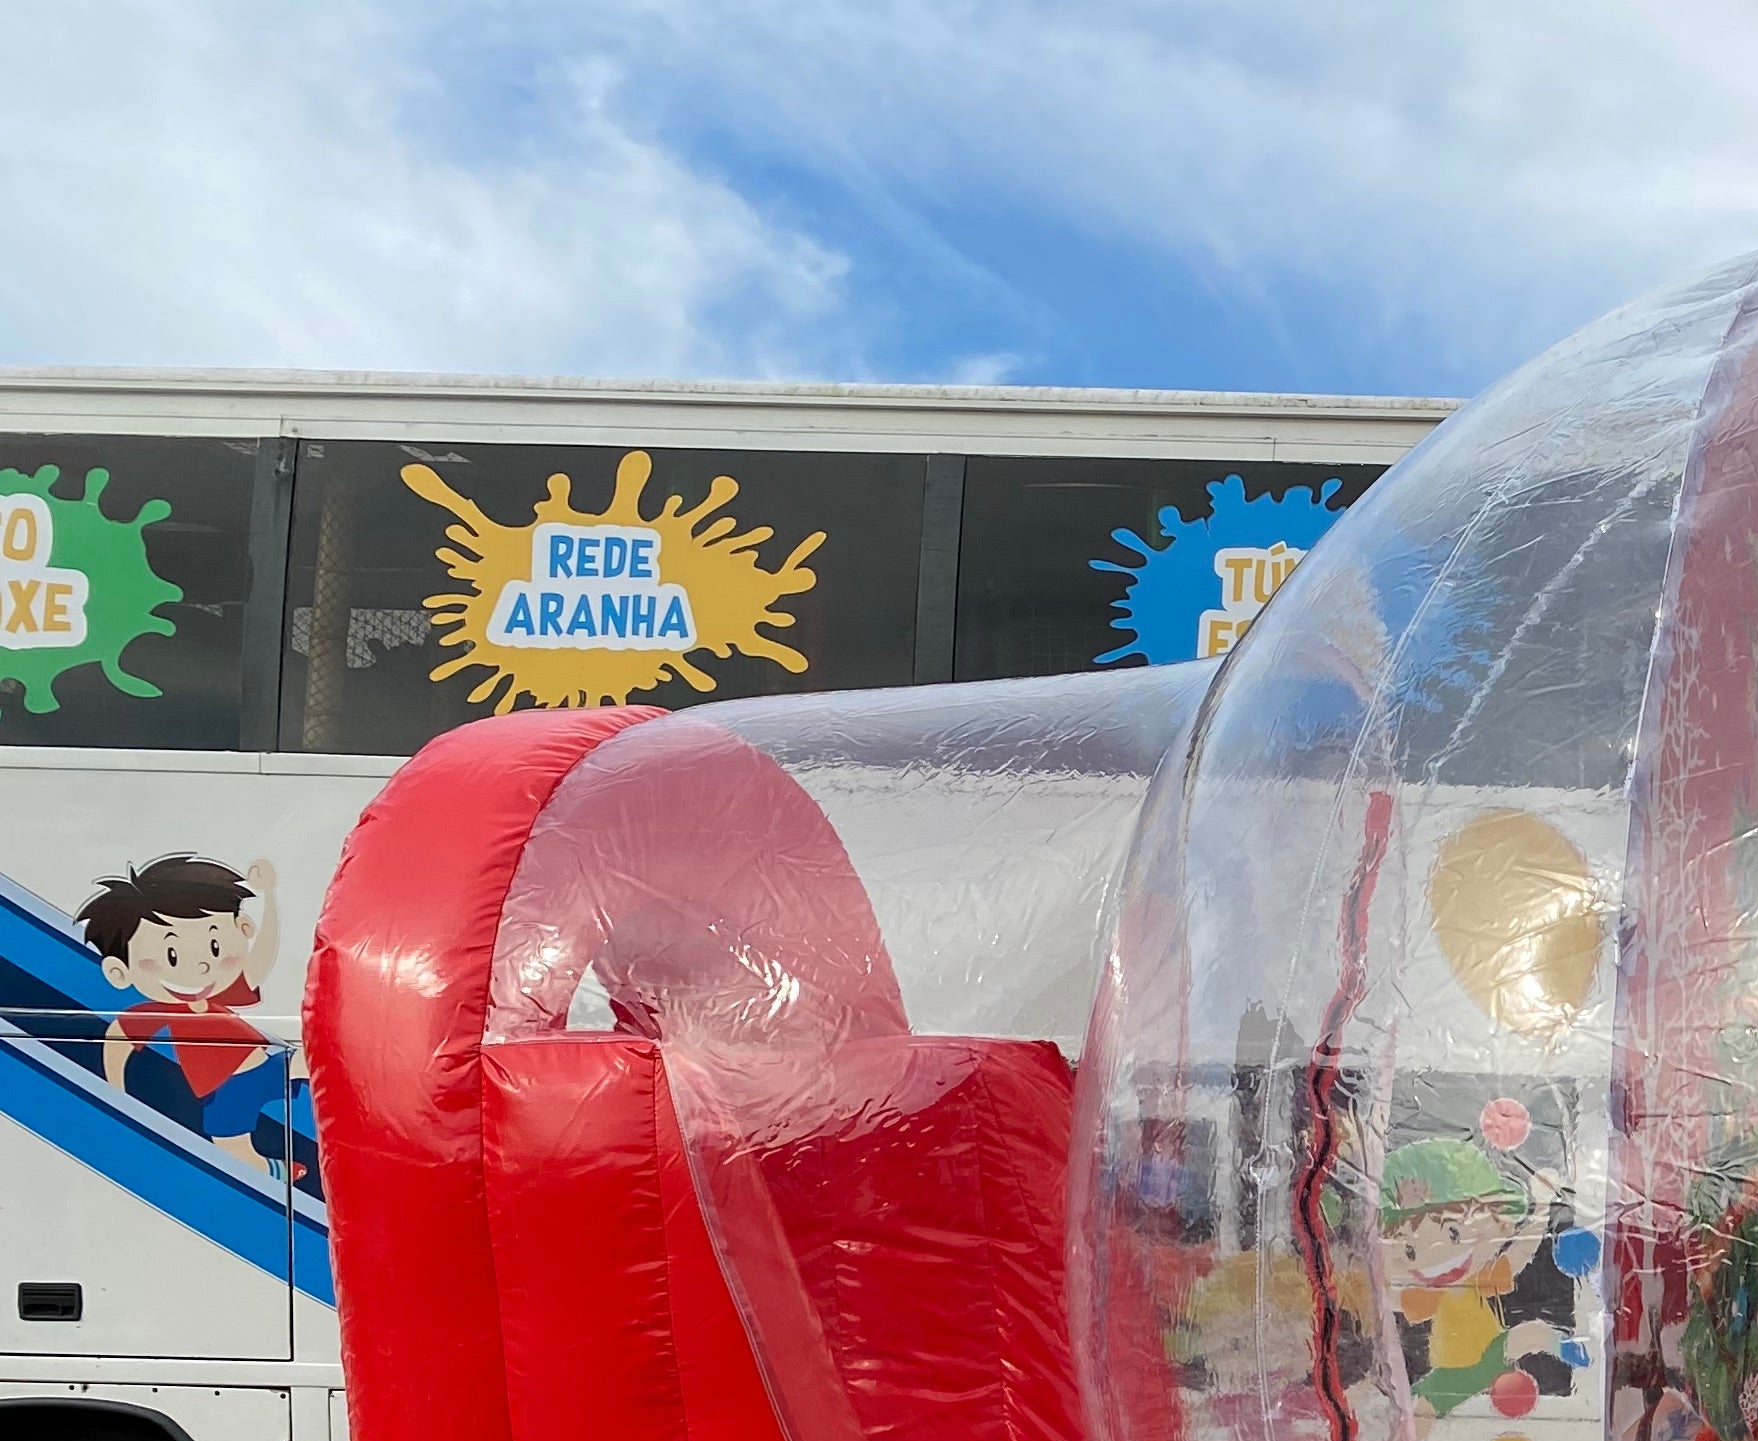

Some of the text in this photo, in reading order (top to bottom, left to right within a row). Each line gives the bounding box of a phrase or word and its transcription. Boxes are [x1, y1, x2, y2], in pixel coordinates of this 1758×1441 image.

[548, 535, 653, 579] REDE
[0, 579, 73, 634] XE
[504, 591, 689, 639] ARANHA
